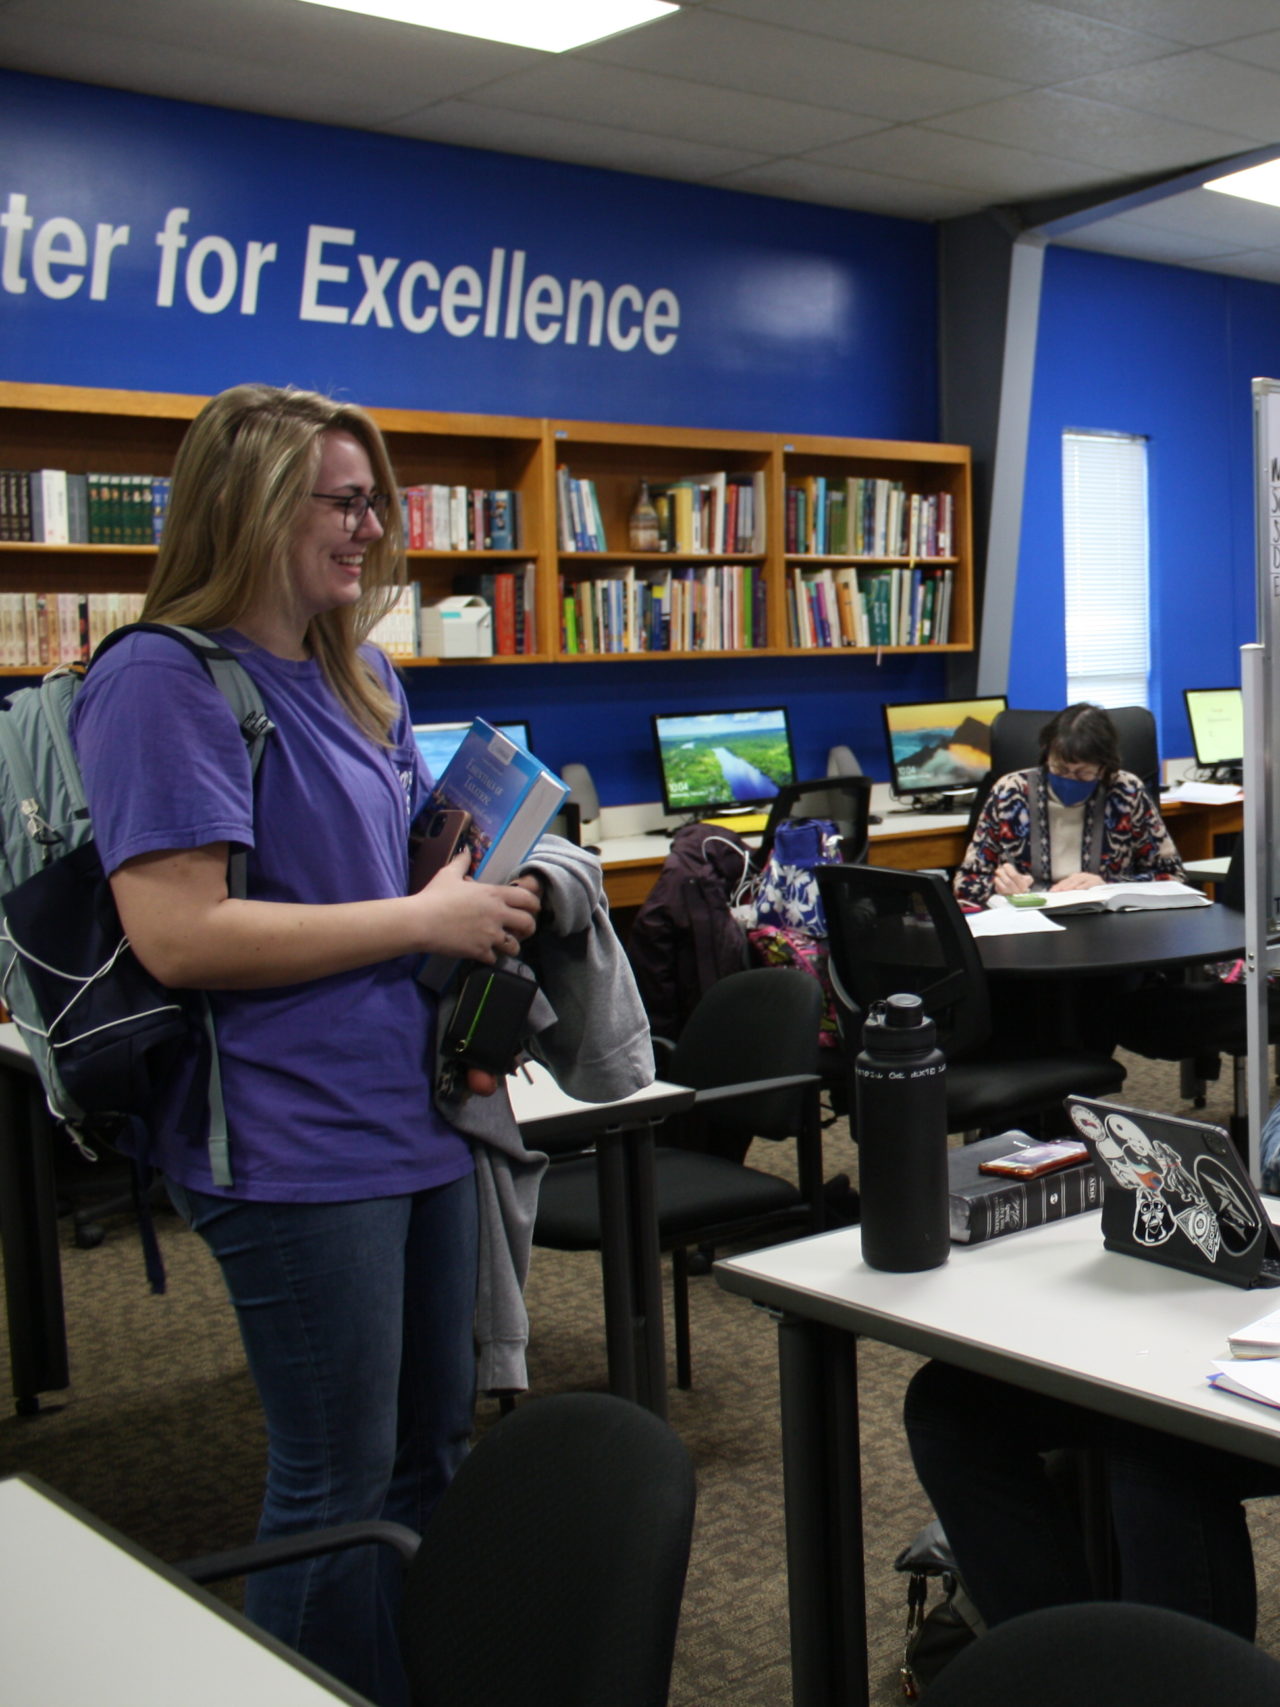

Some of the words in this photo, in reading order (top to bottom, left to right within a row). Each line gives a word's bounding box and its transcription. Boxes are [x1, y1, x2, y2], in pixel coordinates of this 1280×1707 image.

[0, 193, 129, 301] ter
[156, 207, 277, 315] for
[300, 224, 680, 355] Excellence
